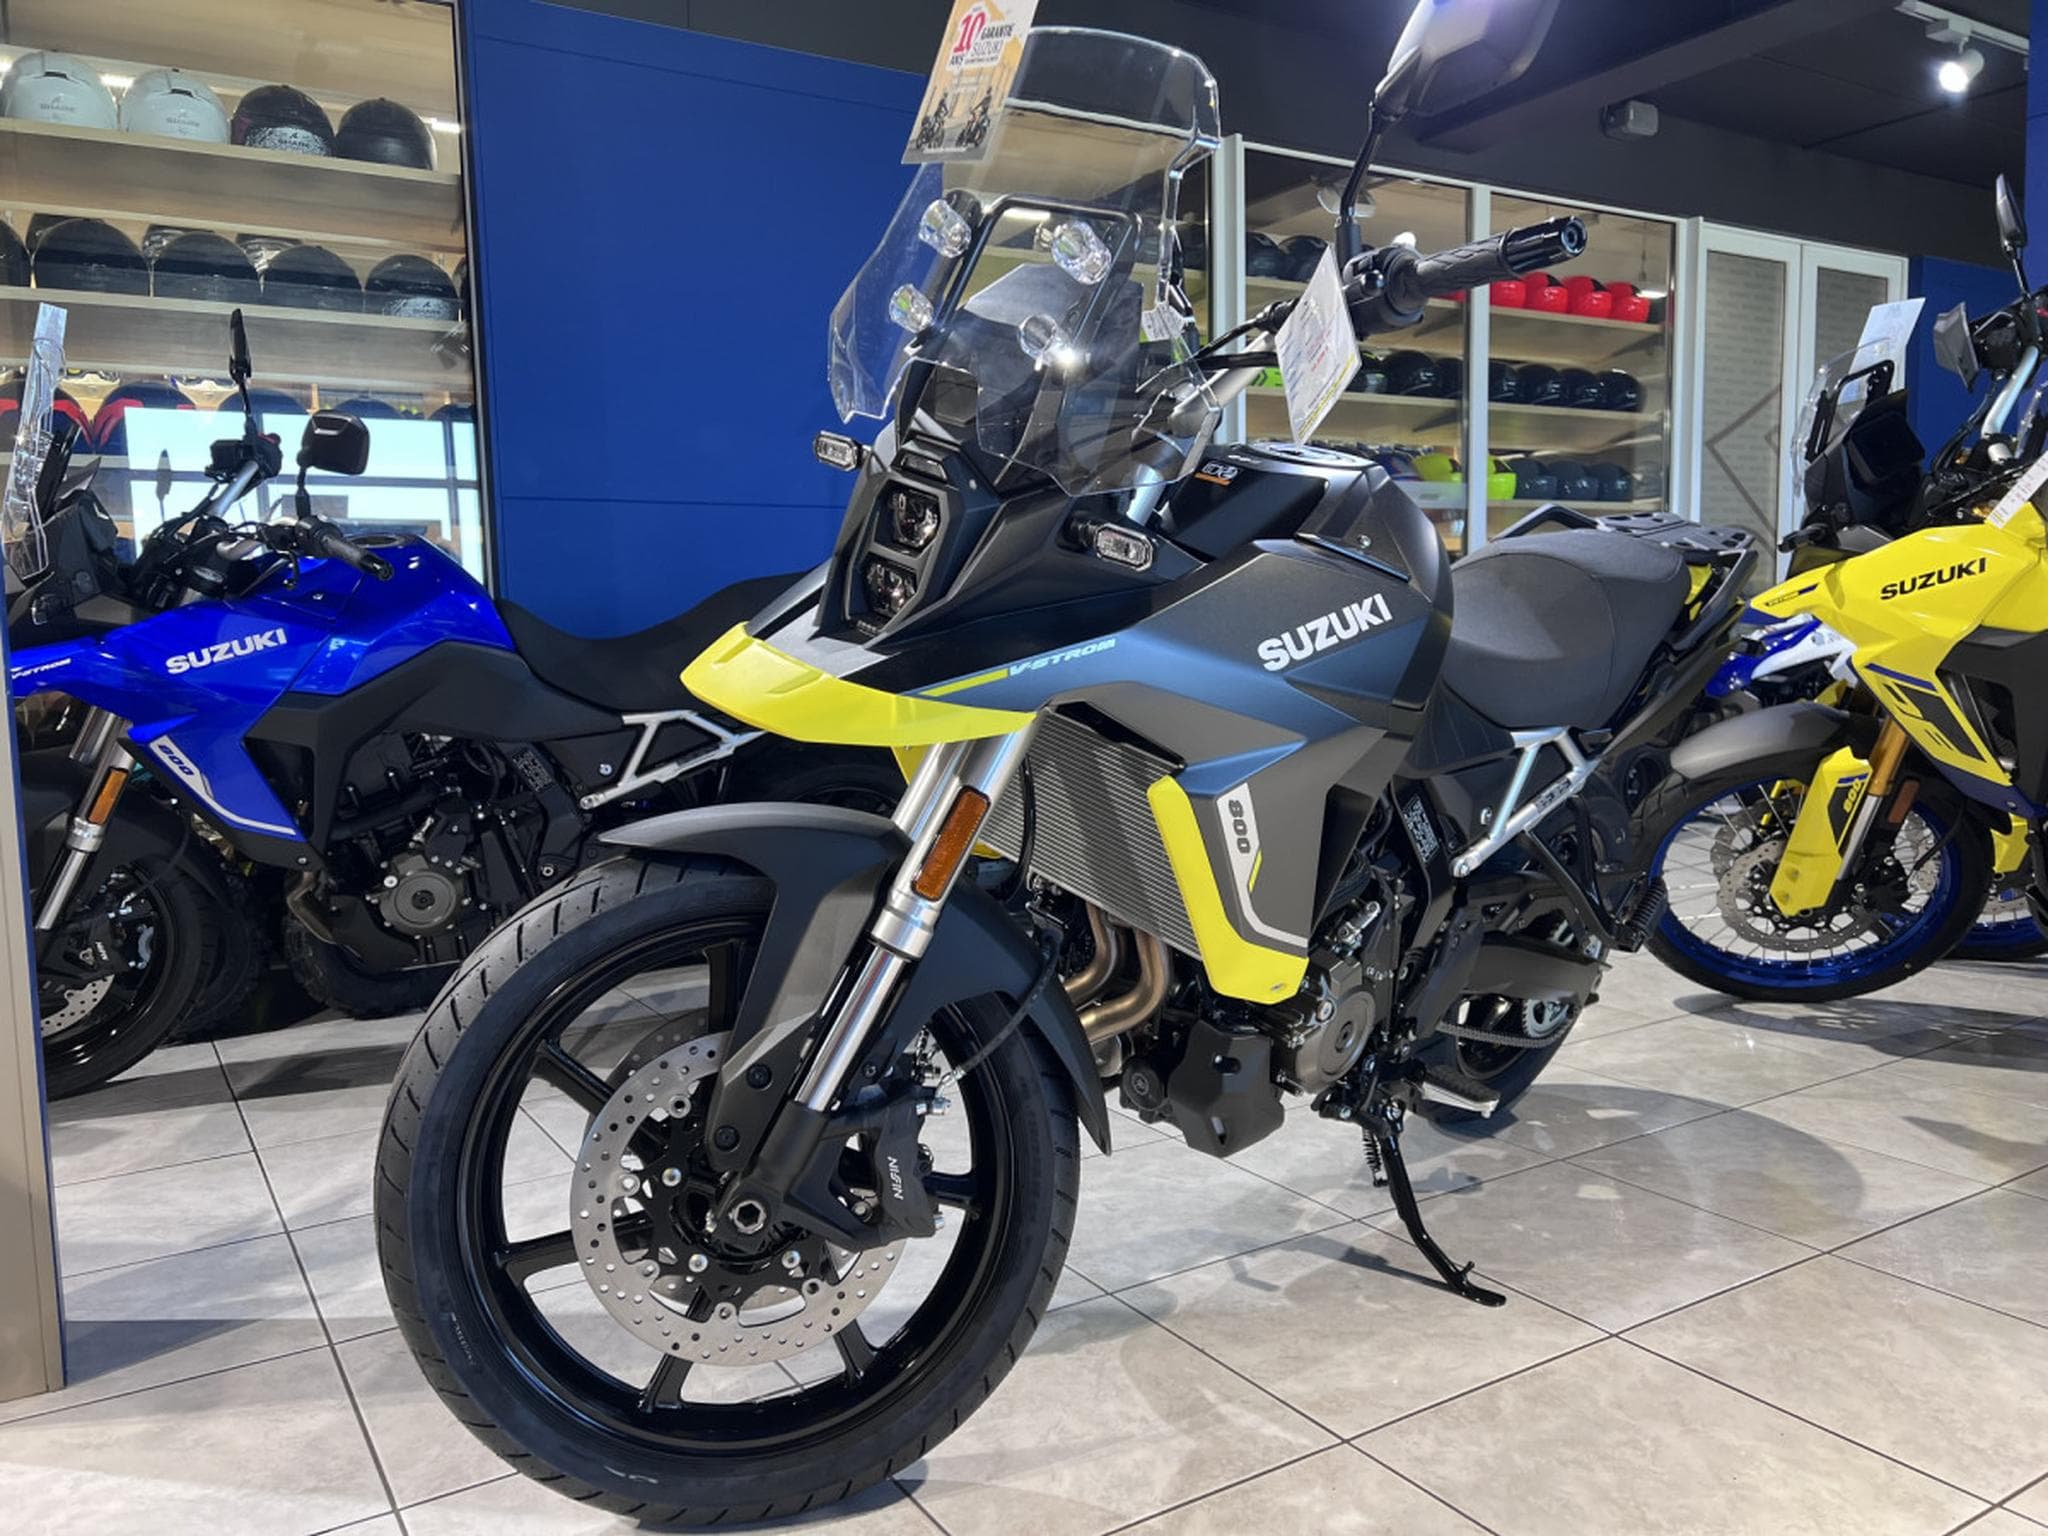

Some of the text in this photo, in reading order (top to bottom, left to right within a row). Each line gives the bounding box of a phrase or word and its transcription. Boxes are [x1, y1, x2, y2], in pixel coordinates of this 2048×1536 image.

[953, 12, 986, 53] 10
[1880, 557, 1987, 600] SUZUKI
[165, 627, 288, 675] SUZUKI
[1257, 592, 1393, 672] SUZUKI
[1009, 637, 1117, 677] V-STROM
[1843, 777, 1862, 813] 800
[1228, 799, 1251, 853] 800
[887, 1156, 904, 1200] NISSIN
